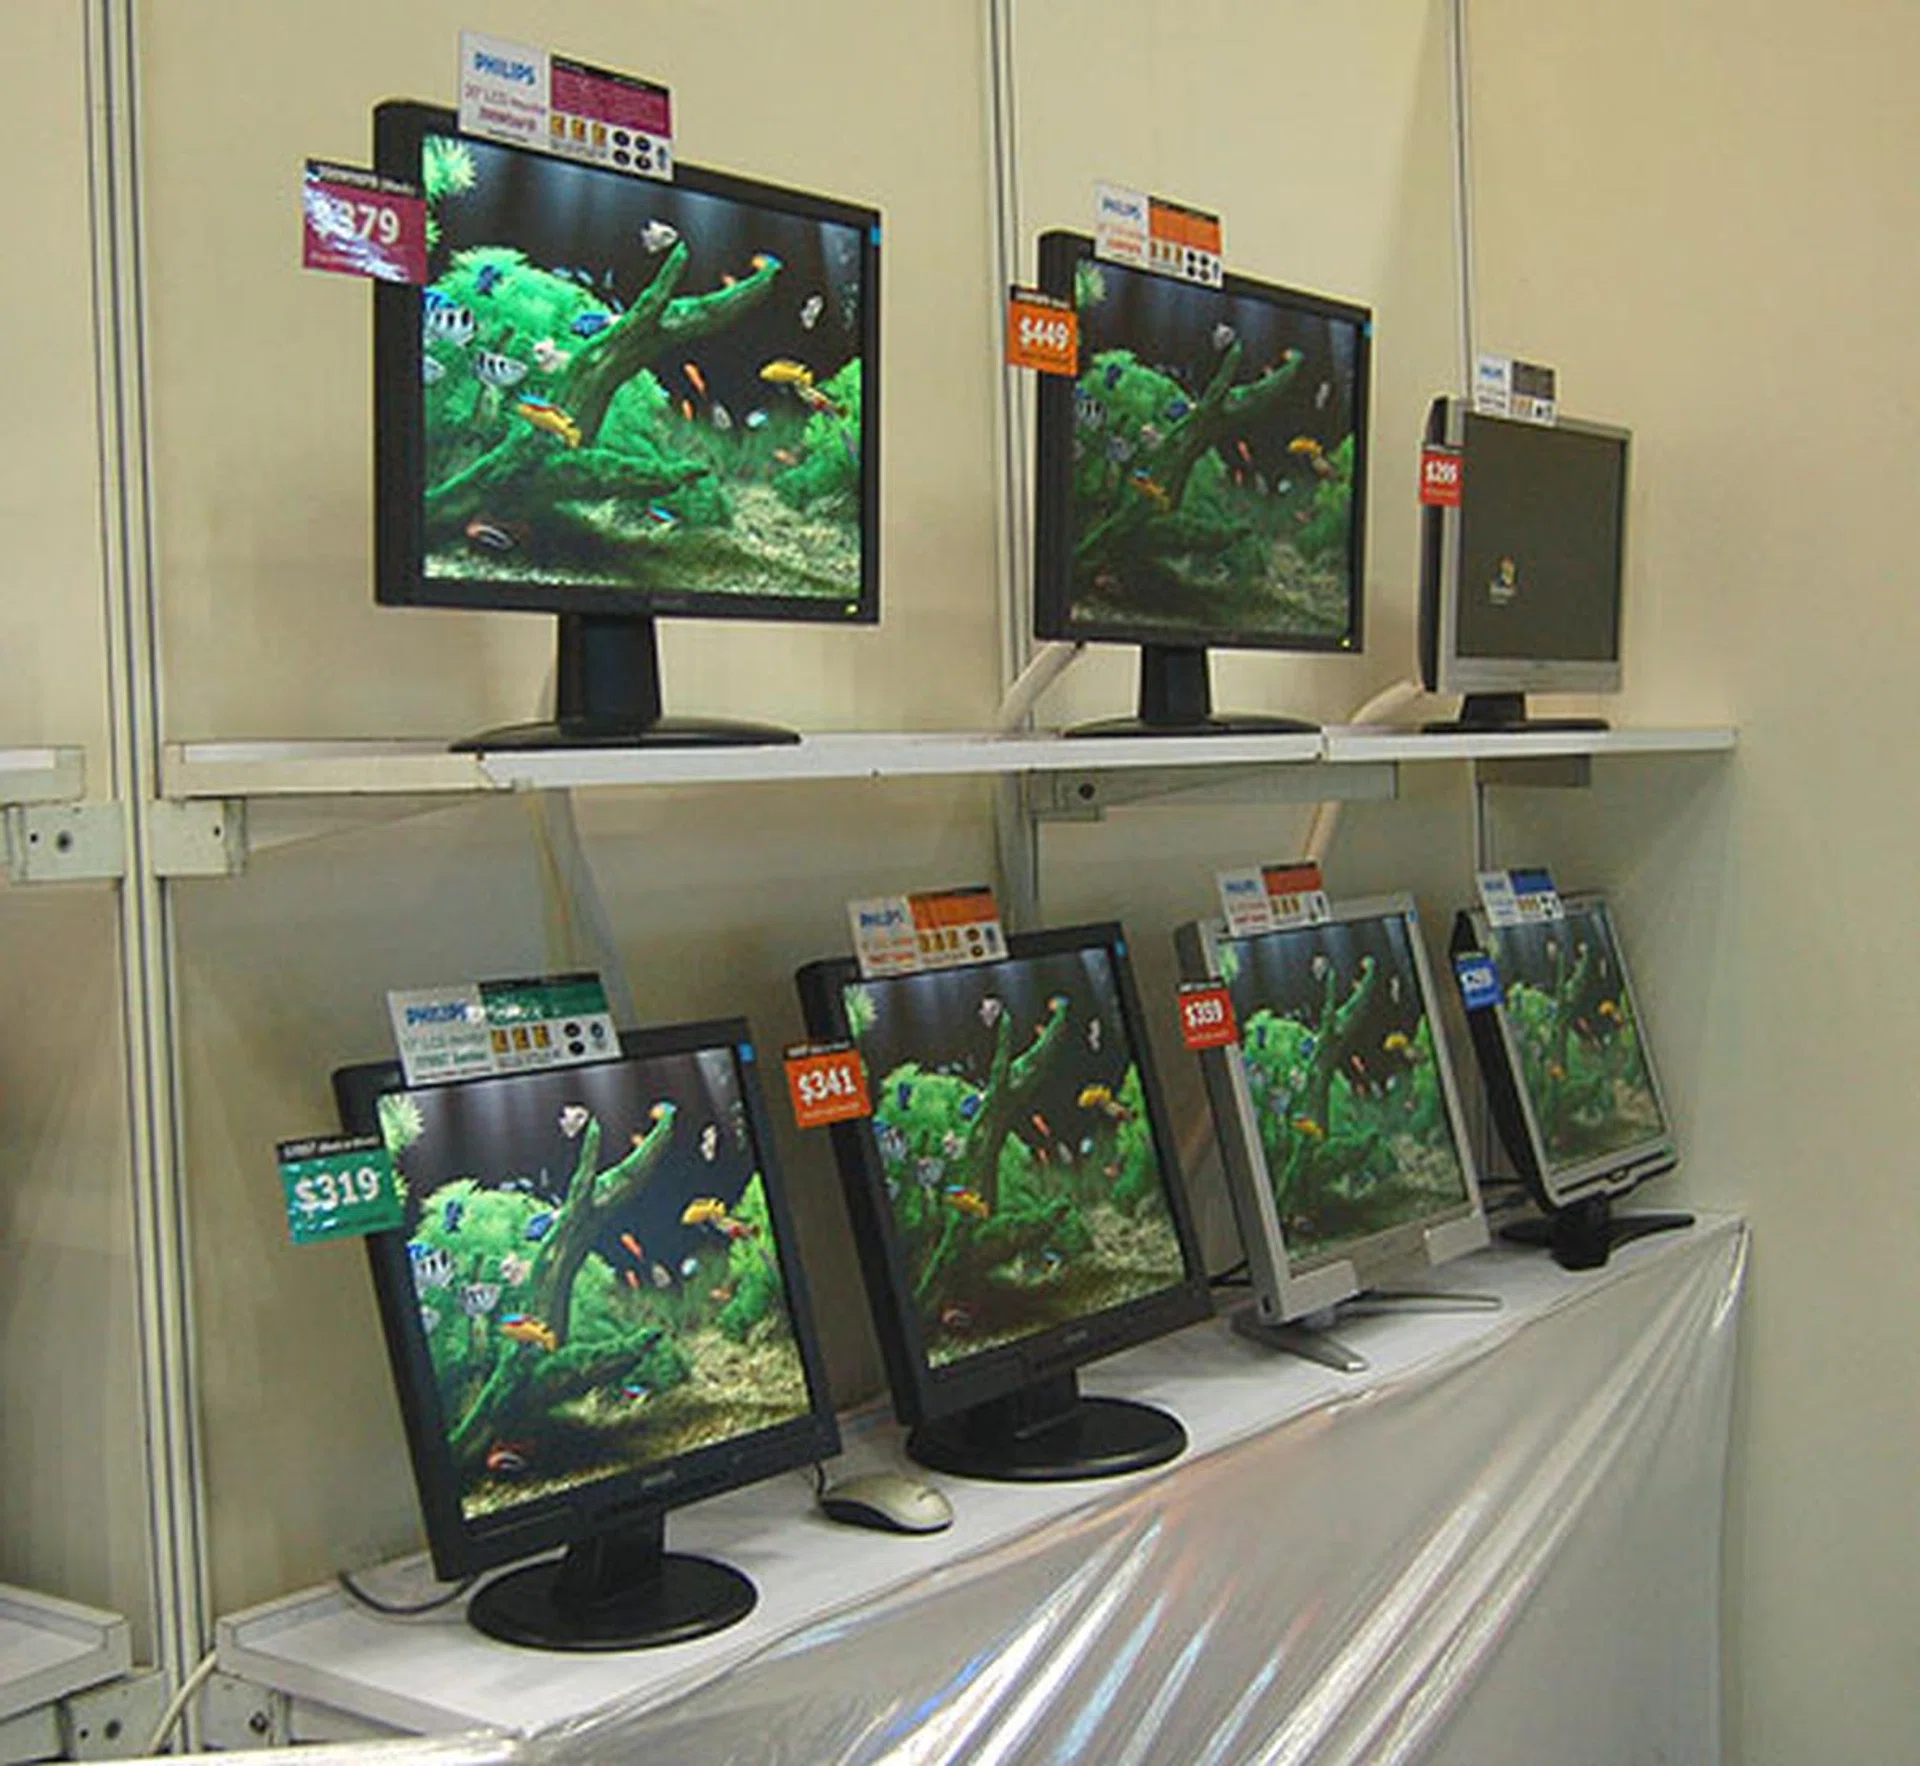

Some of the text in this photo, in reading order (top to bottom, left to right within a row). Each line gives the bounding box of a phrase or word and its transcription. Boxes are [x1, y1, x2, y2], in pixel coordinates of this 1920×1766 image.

[473, 51, 537, 86] PHILIPS
[1020, 317, 1069, 351] $449
[798, 1066, 857, 1107] $341
[294, 1166, 380, 1220] $319
